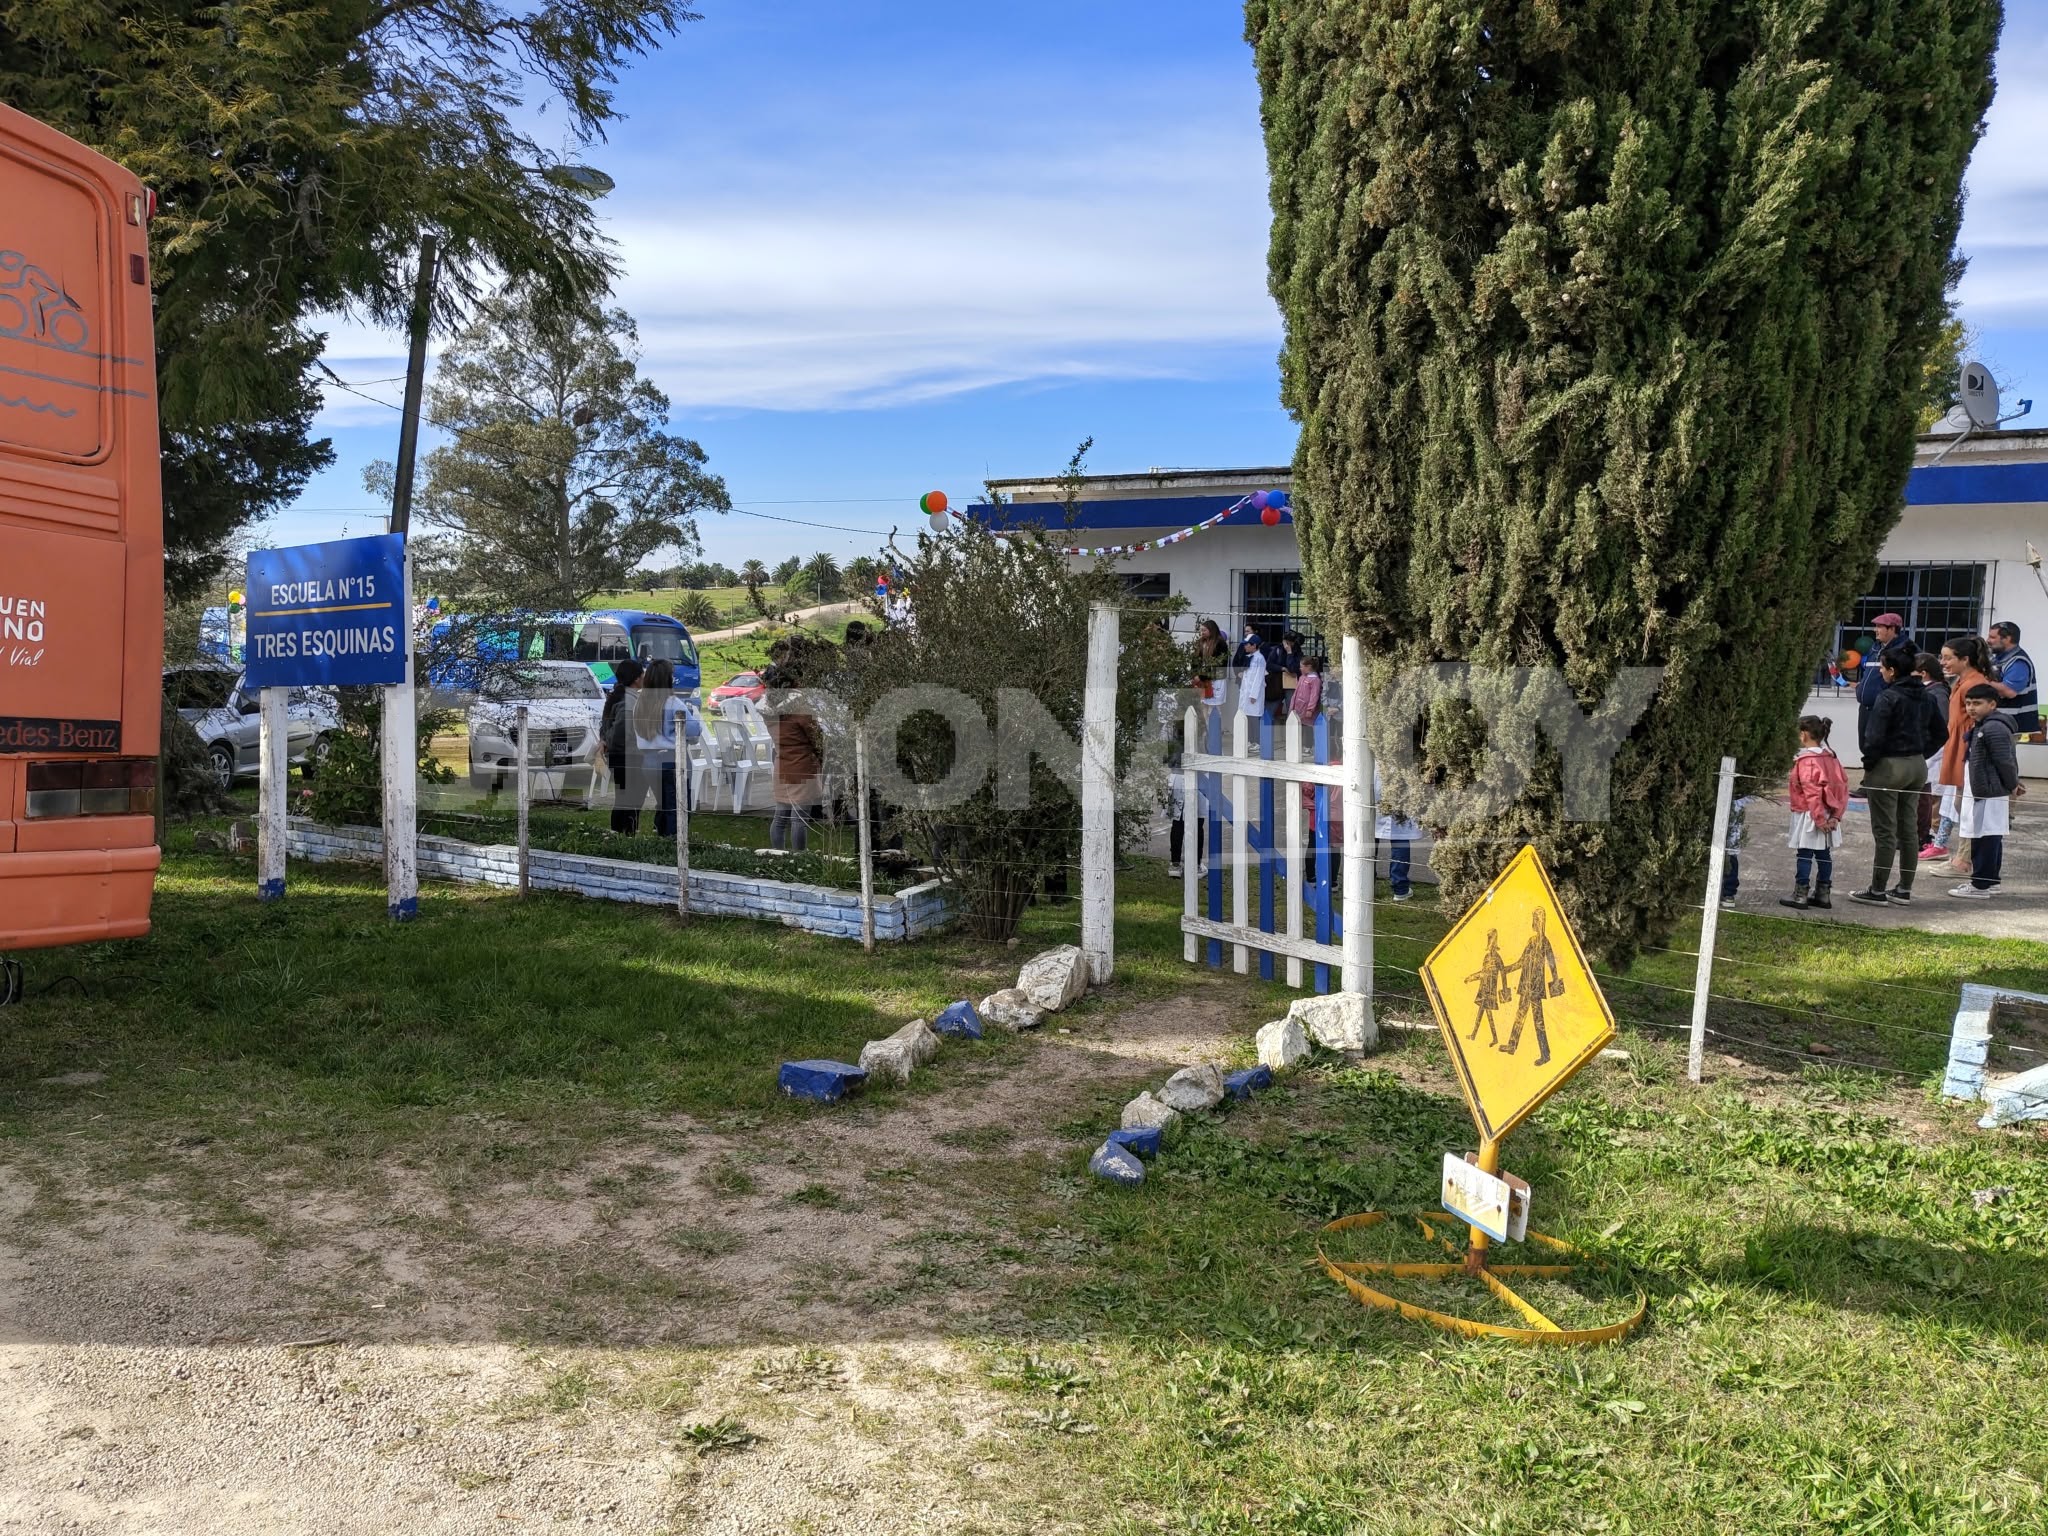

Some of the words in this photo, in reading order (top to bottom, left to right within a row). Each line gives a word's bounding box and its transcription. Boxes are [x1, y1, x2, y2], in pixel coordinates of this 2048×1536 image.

[271, 579, 335, 606] ESCUELA
[339, 575, 375, 600] N°15
[254, 632, 297, 659] TRES
[302, 625, 395, 659] ESQUINAS
